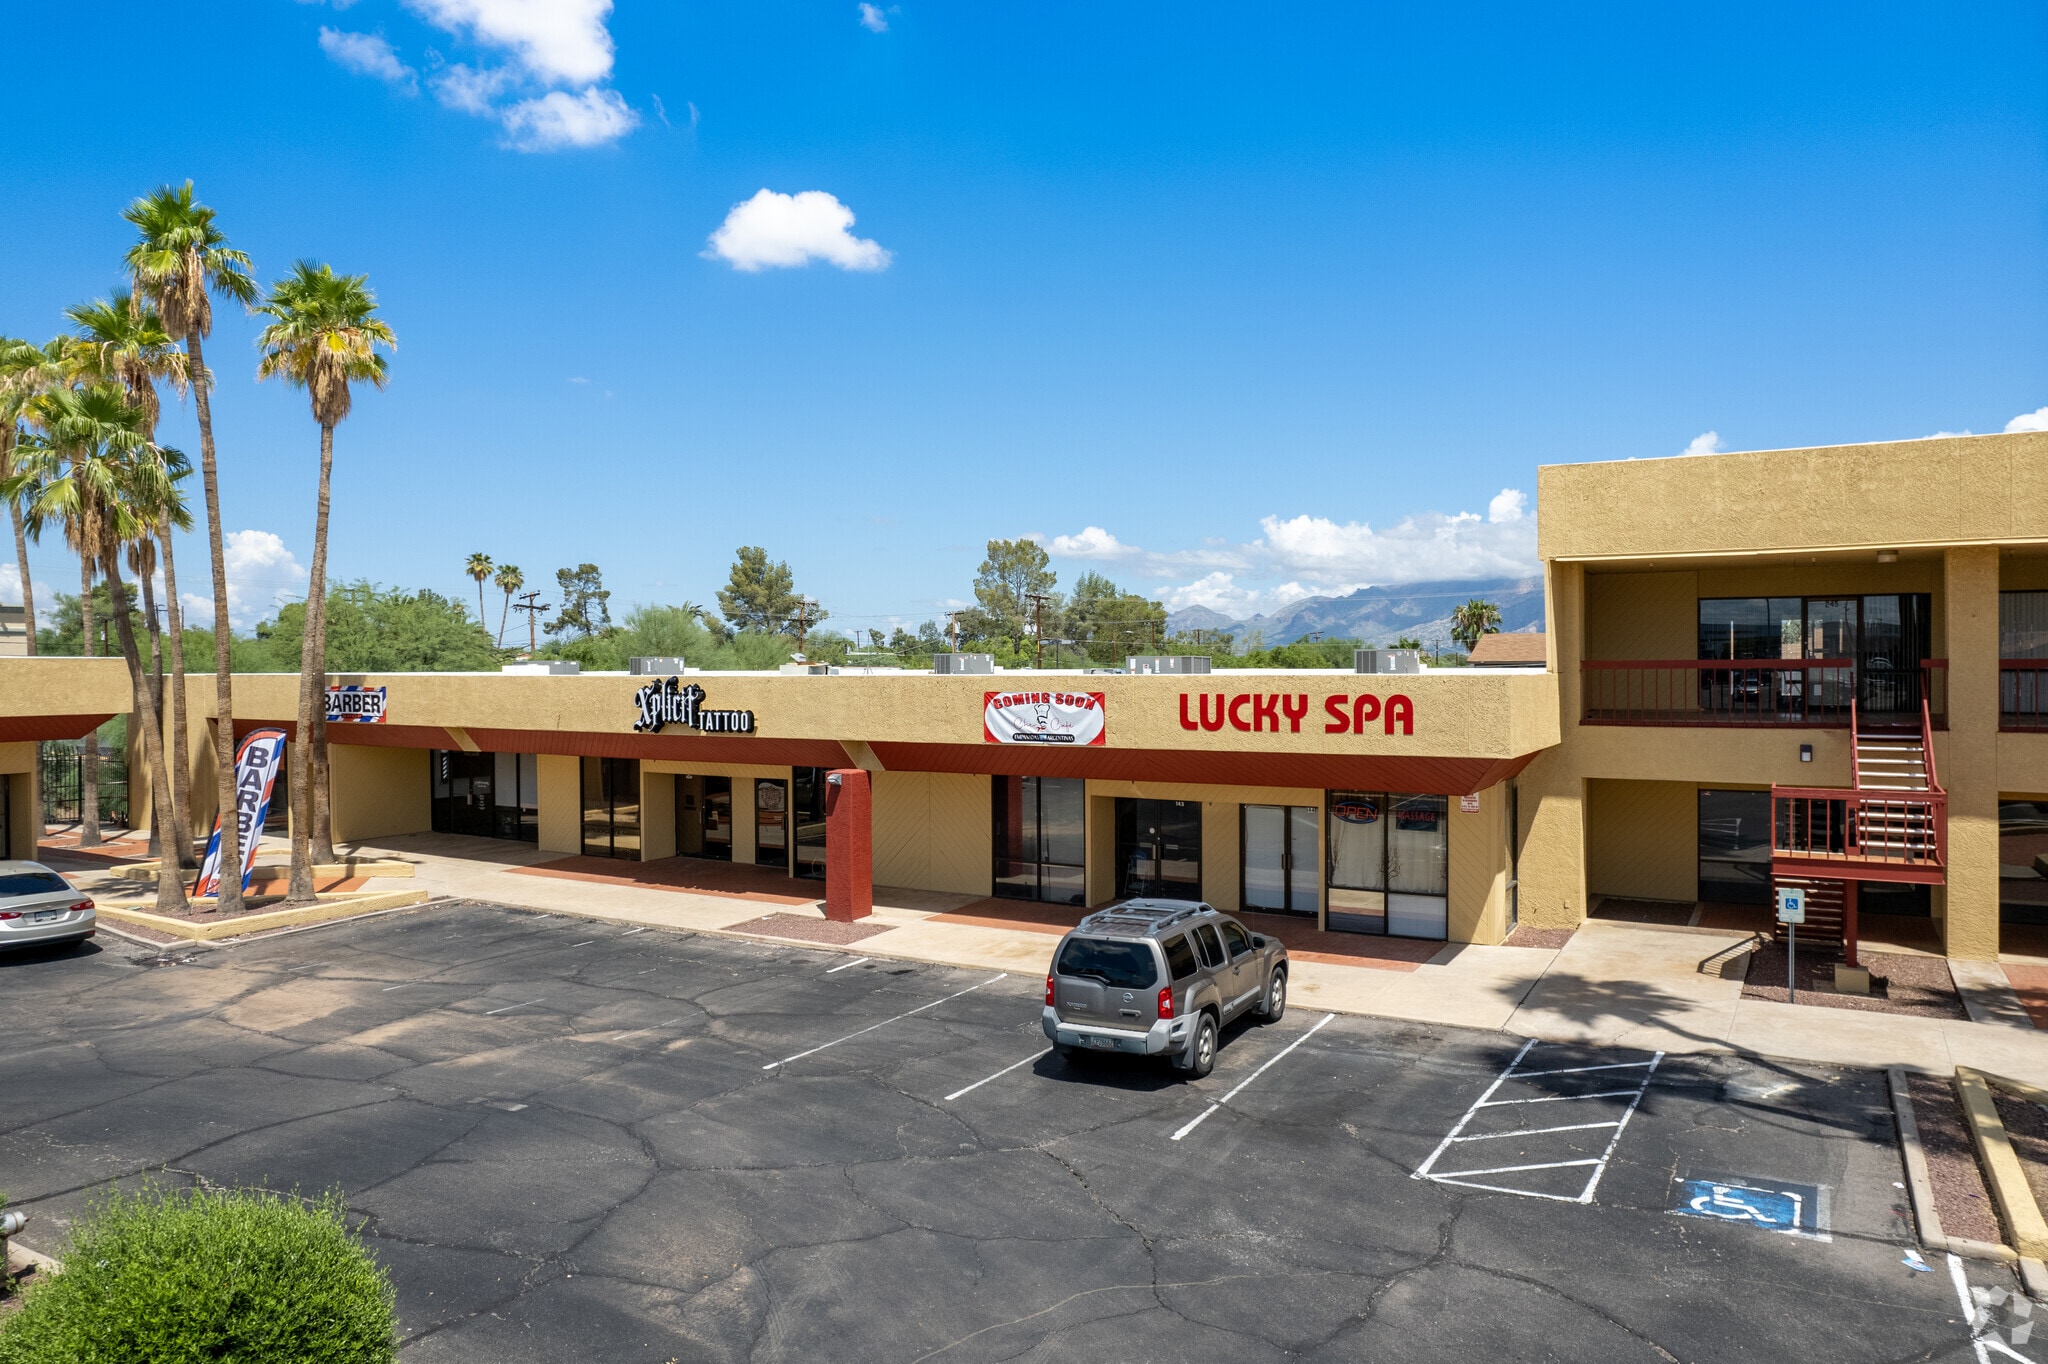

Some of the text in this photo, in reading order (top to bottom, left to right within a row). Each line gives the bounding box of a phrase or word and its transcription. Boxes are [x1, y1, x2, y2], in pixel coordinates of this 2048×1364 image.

[634, 677, 751, 732] Xplicit TATTOO
[993, 692, 1096, 710] COMING SOON
[1179, 694, 1414, 735] LUCKY SPA
[1334, 804, 1378, 821] OPEN
[1397, 811, 1436, 822] MASSAGE
